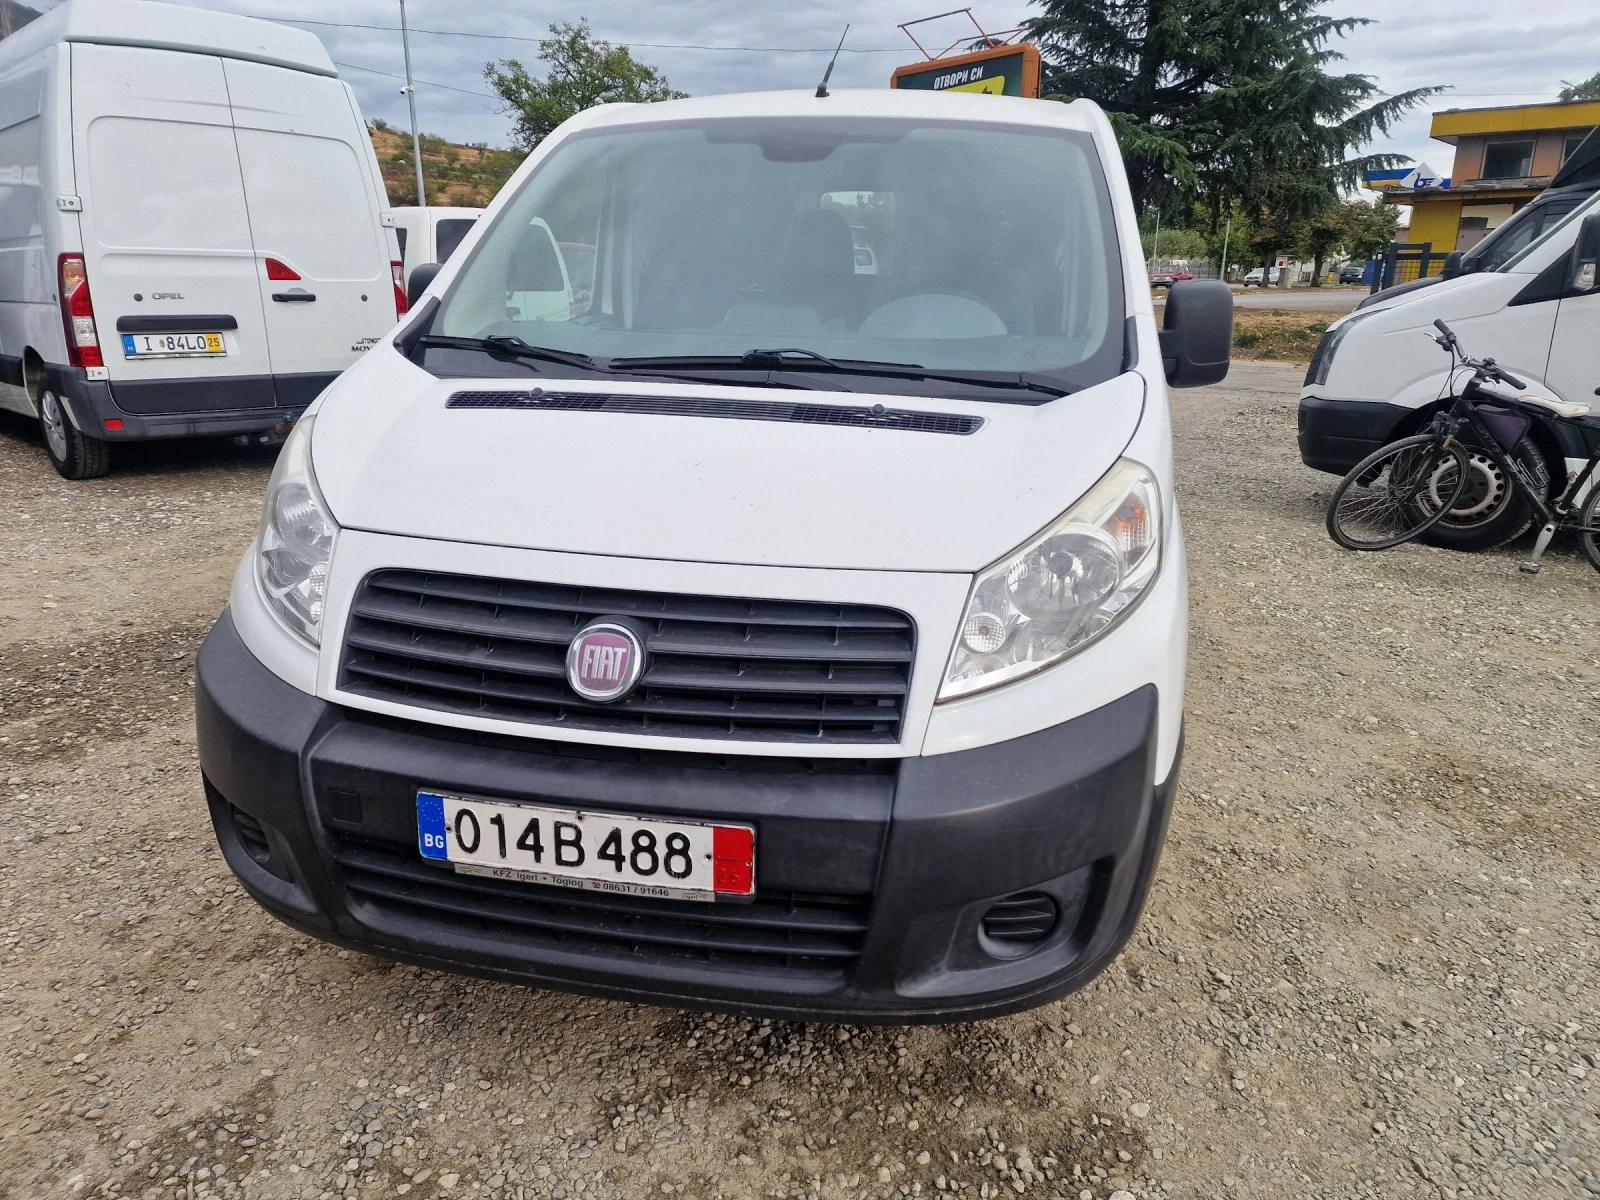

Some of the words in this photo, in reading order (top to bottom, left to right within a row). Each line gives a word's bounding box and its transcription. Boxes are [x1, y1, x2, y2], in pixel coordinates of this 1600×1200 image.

[933, 70, 969, 90] ОТВОРИ
[970, 66, 984, 81] СИ
[152, 292, 185, 300] OPEL
[207, 337, 220, 348] 25
[581, 644, 627, 680] FIAT
[424, 833, 445, 849] BG
[454, 808, 693, 880] 014B488
[492, 869, 512, 878] KFZ
[603, 880, 631, 893] 08631
[640, 886, 669, 897] 91646
